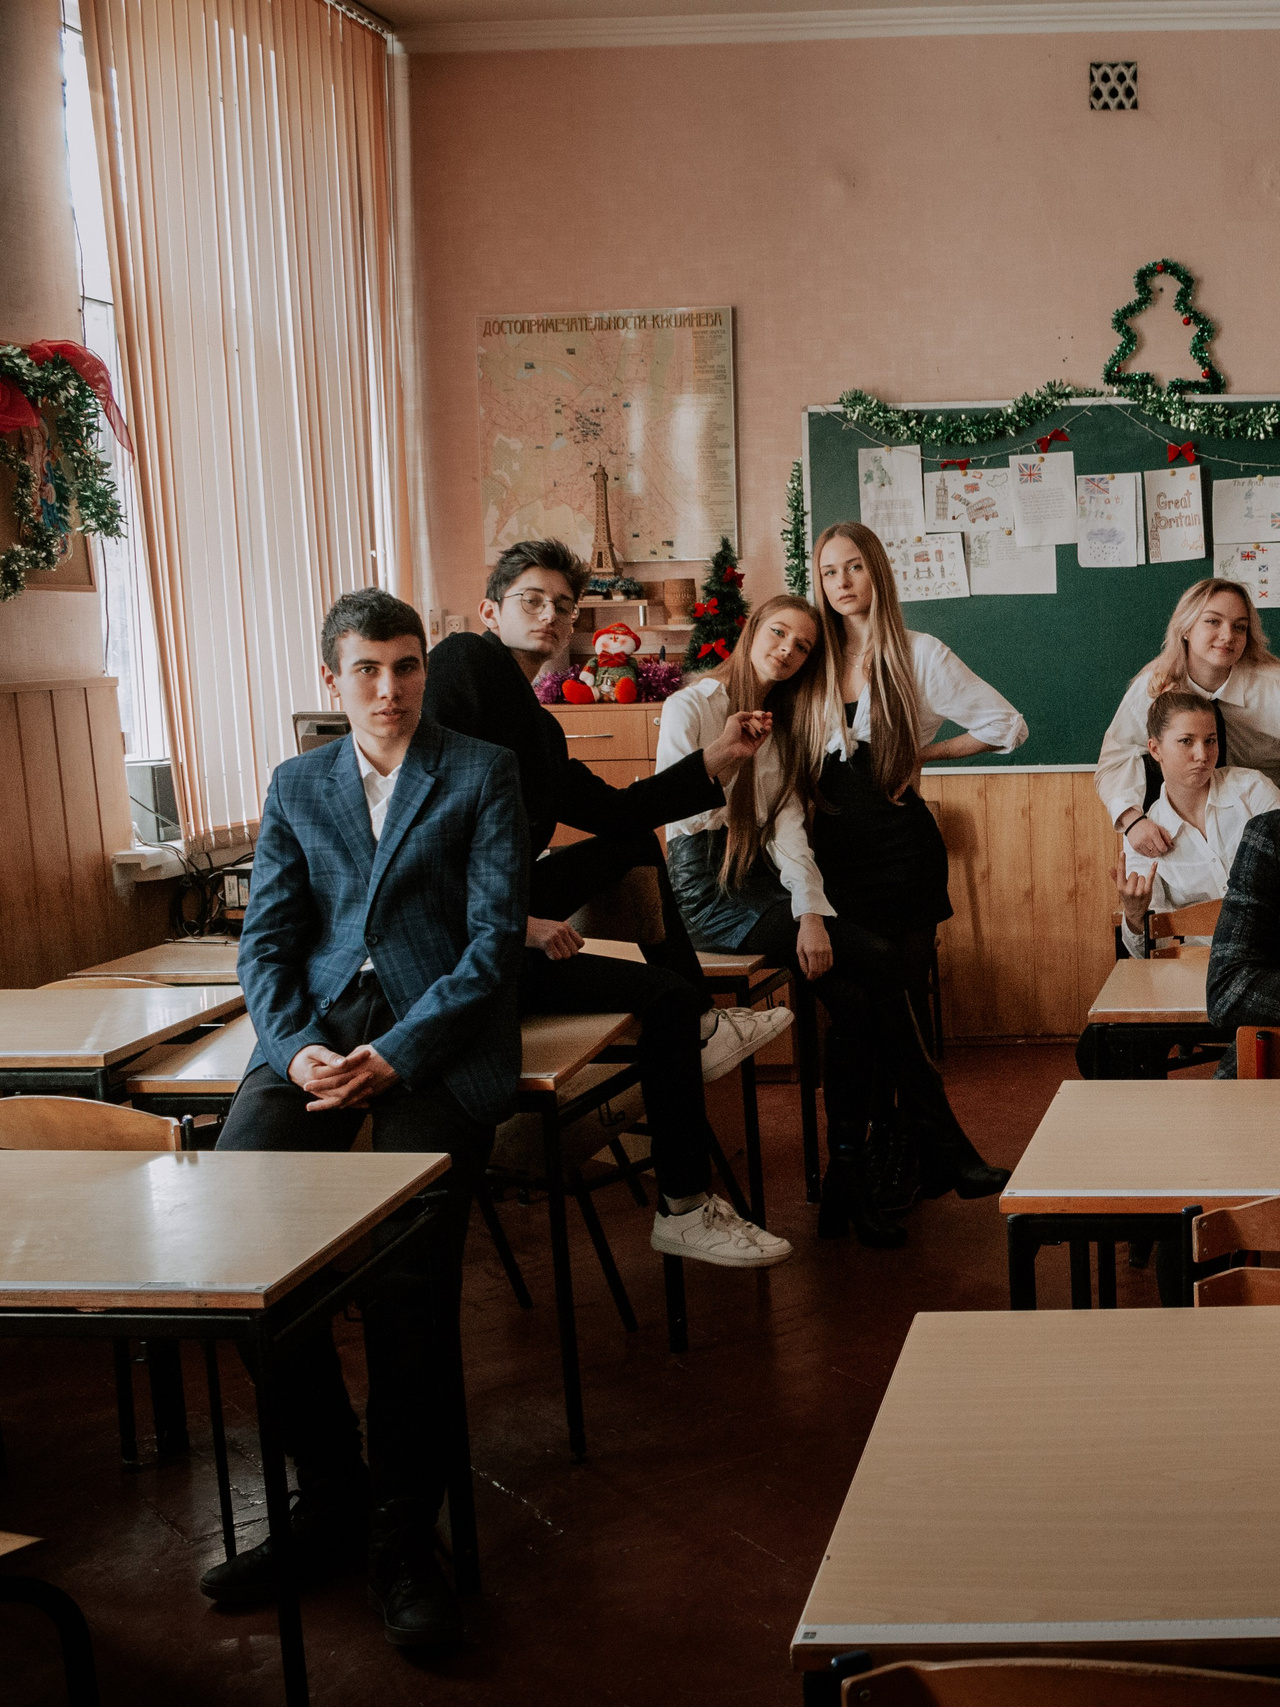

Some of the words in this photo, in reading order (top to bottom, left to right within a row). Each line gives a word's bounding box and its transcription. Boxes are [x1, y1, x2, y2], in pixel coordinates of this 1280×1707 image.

[482, 315, 647, 337] ДОСТОПРИМЕЧАТЕЛЬНОСТИ
[651, 312, 722, 330] КИШИНЕВА
[1156, 489, 1193, 510] Great
